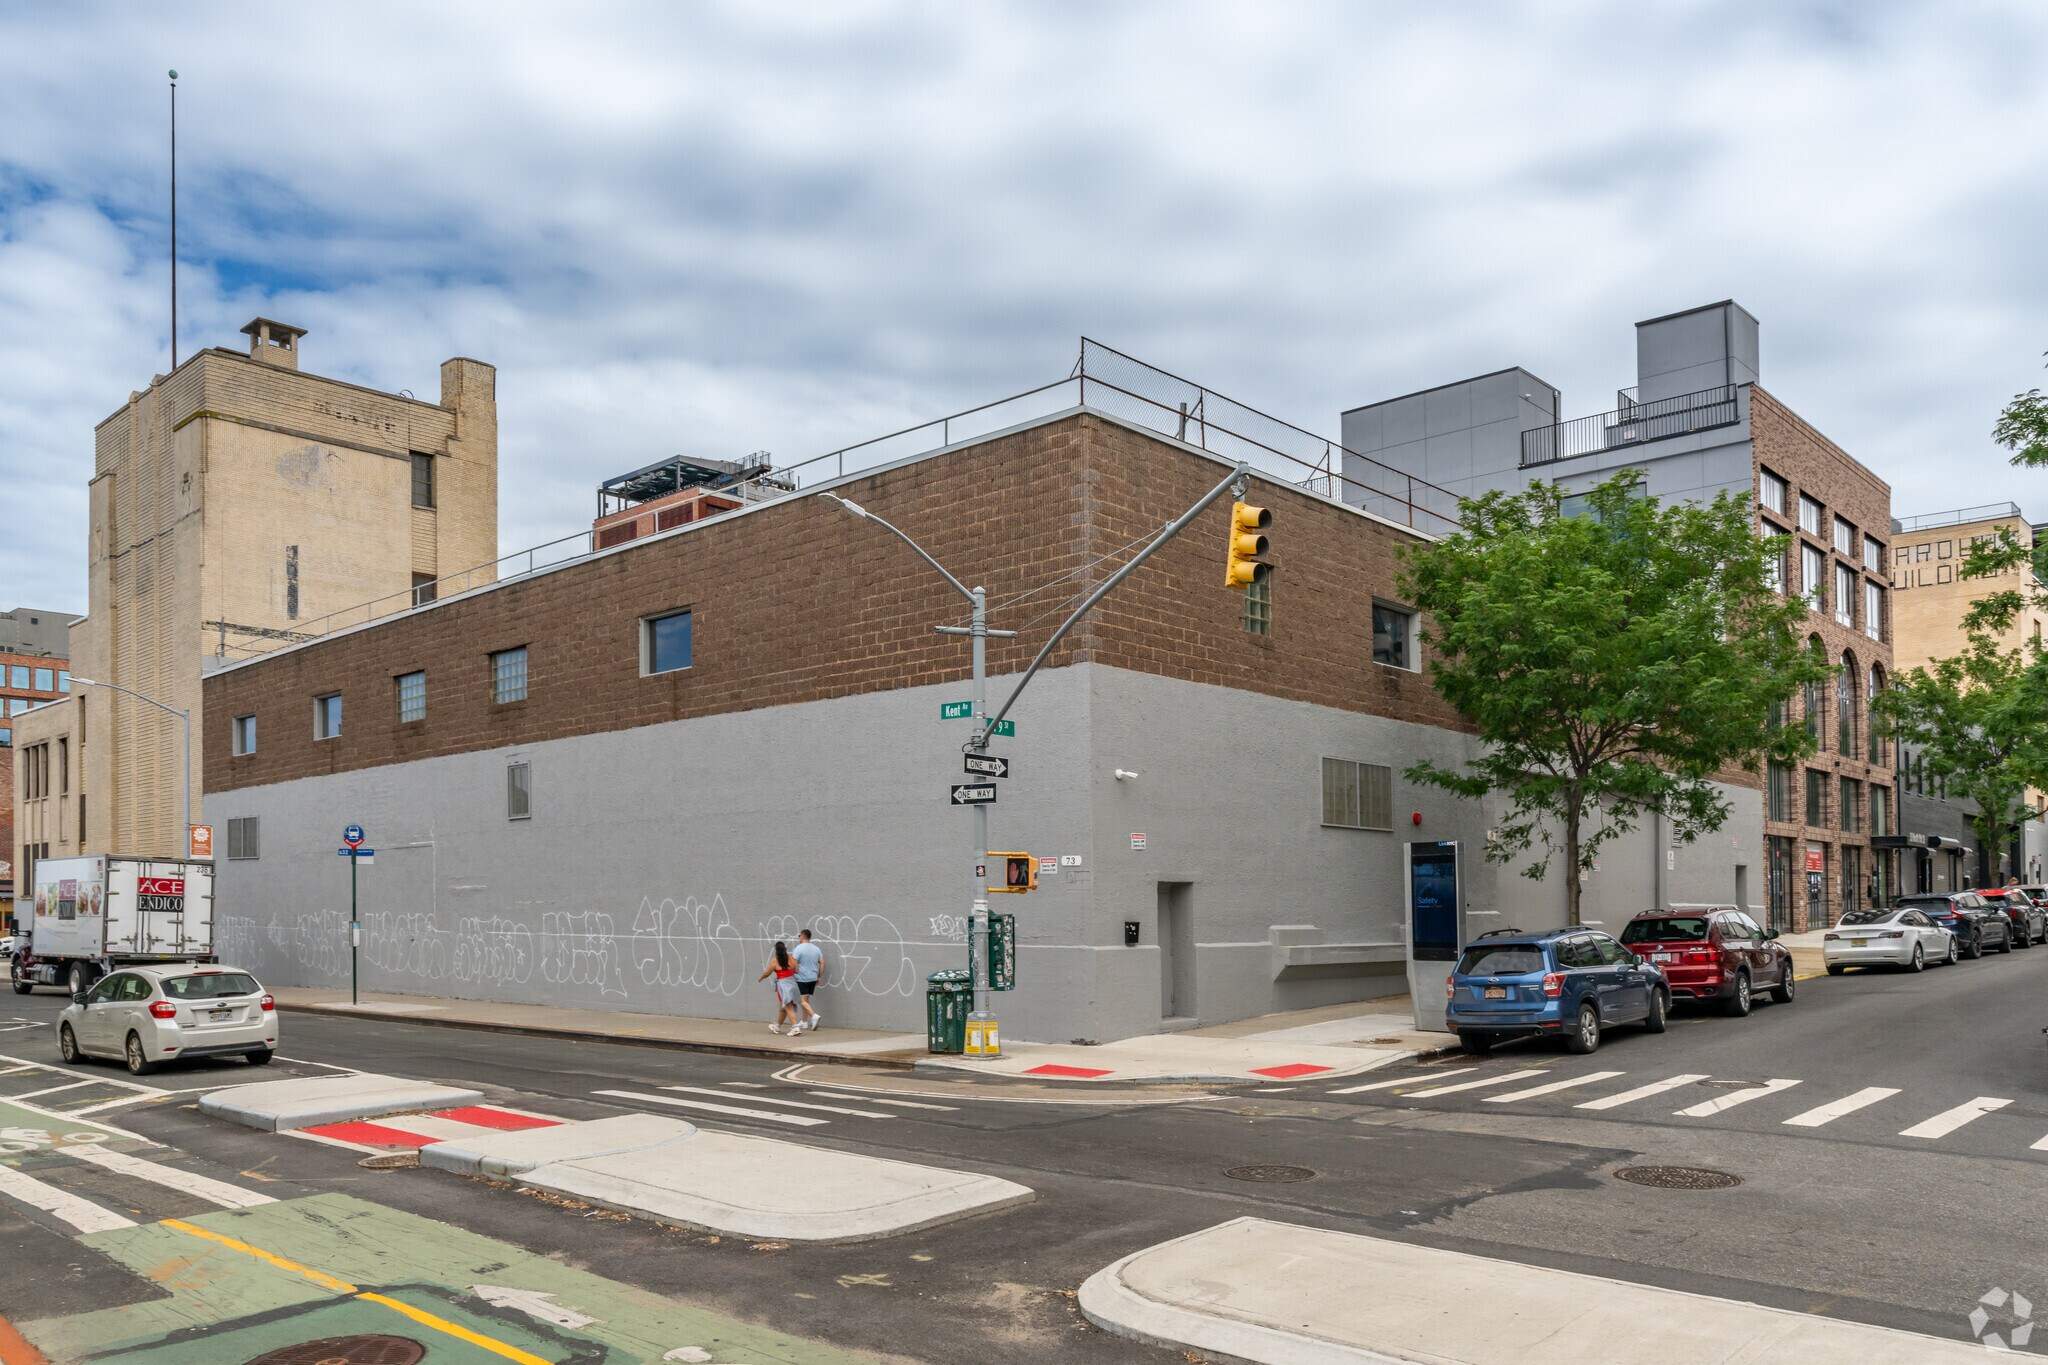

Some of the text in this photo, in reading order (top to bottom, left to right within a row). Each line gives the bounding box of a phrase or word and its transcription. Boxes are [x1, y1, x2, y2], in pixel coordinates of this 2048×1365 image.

[945, 704, 961, 718] Kent
[998, 721, 1003, 733] 9
[970, 760, 1002, 772] ONE WAY
[957, 789, 991, 799] ONE WAY
[1066, 857, 1076, 865] 73
[59, 882, 77, 897] ACE
[139, 880, 184, 894] ACE
[138, 896, 184, 911] ENDICO
[1417, 896, 1439, 904] Safety
